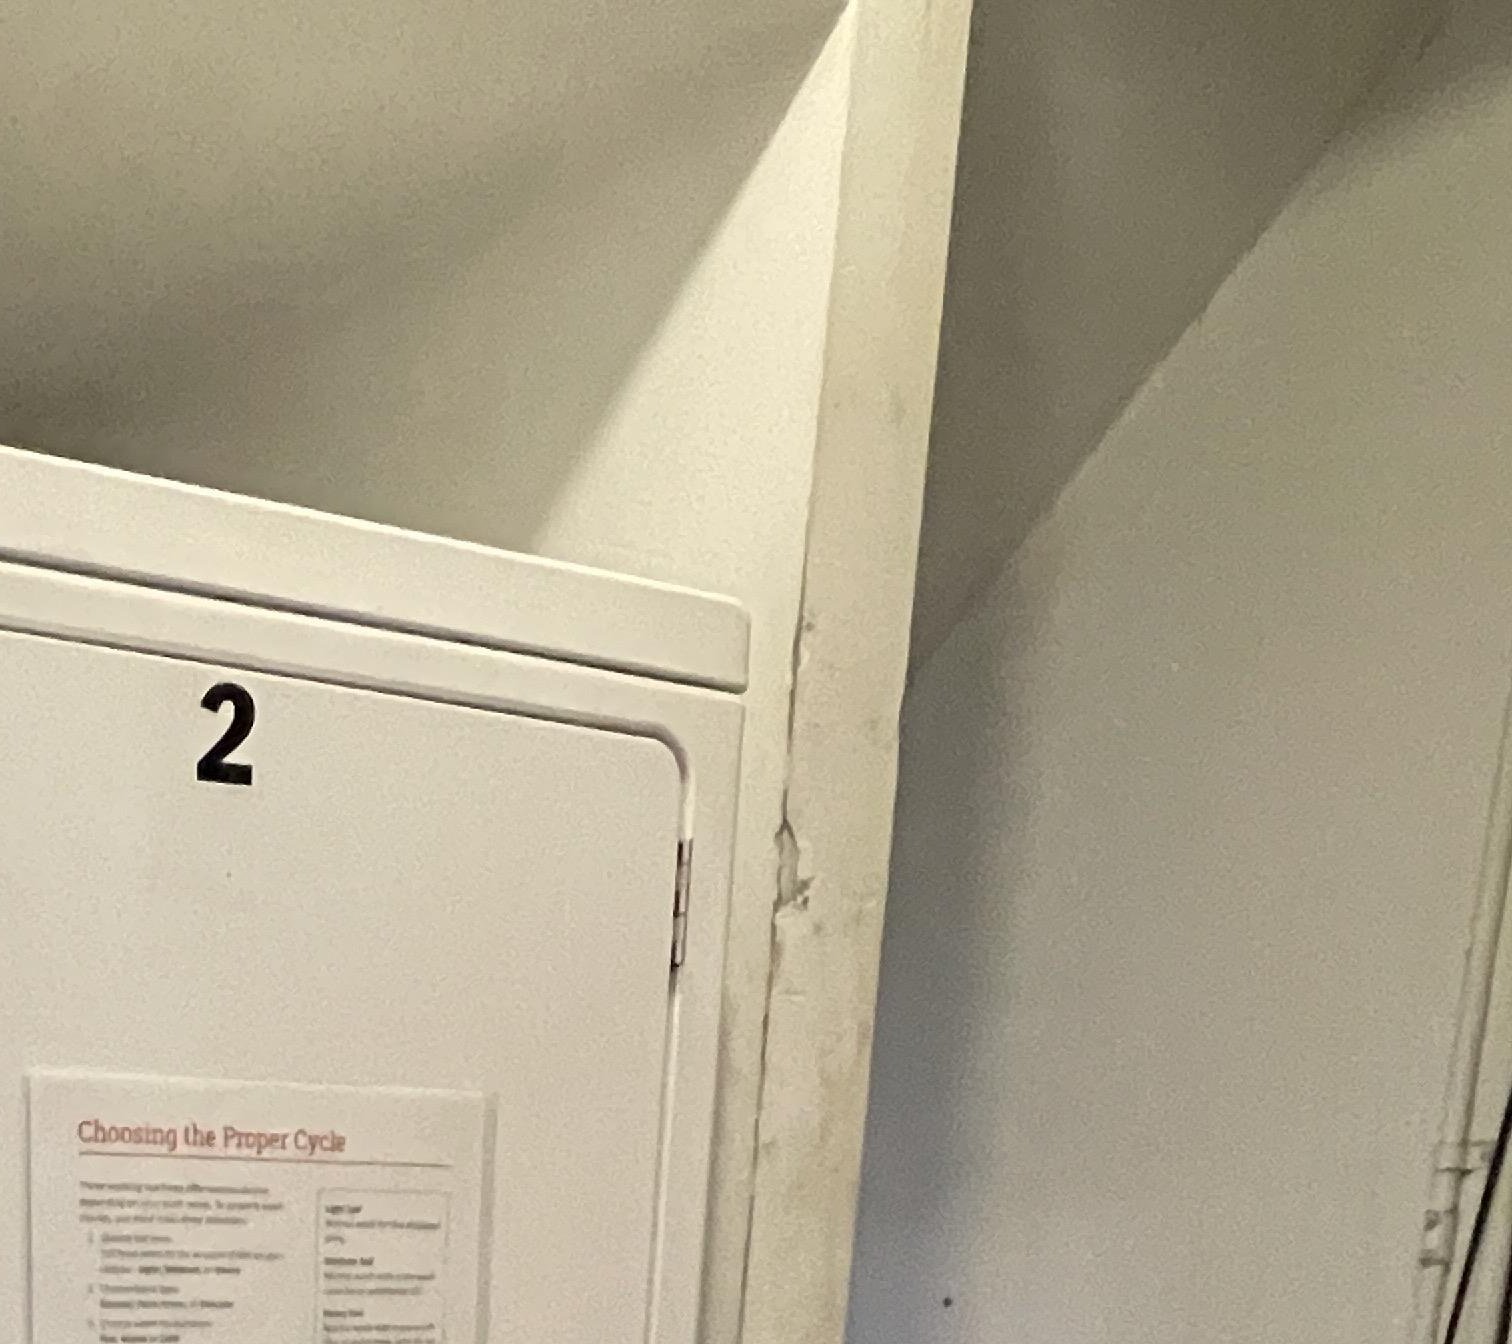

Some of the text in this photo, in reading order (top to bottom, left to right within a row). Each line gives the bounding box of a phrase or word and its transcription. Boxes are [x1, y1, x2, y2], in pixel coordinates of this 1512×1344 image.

[196, 682, 256, 786] 2
[77, 1119, 346, 1156] Choosing the Proper Cycle
